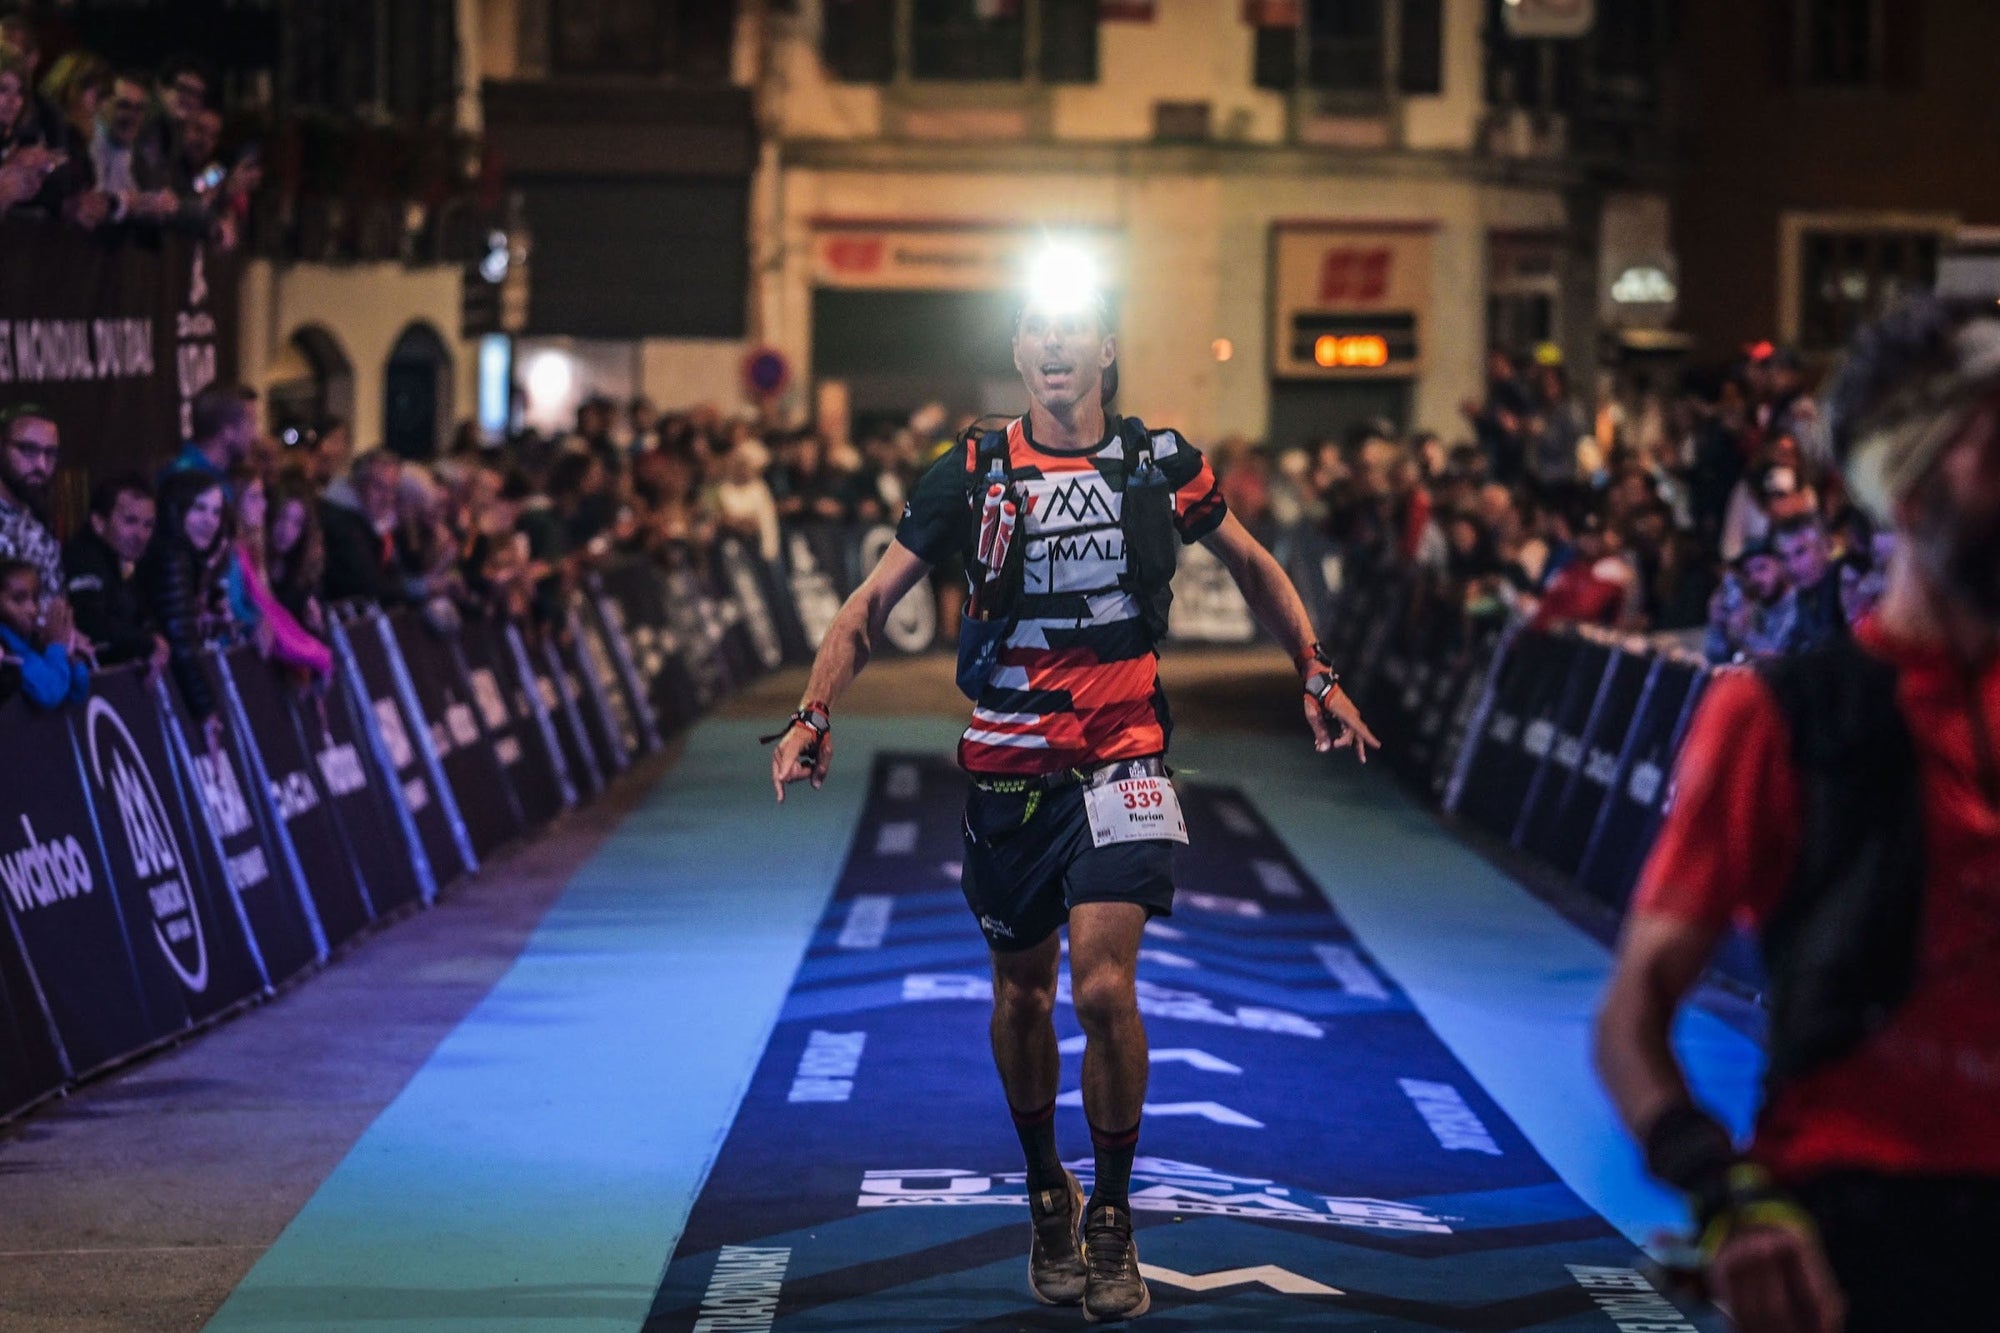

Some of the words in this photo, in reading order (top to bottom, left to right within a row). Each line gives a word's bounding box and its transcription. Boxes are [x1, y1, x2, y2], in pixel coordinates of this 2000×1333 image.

[1123, 791, 1163, 809] 339
[1129, 811, 1164, 822] Florian
[0, 813, 93, 912] wahoo
